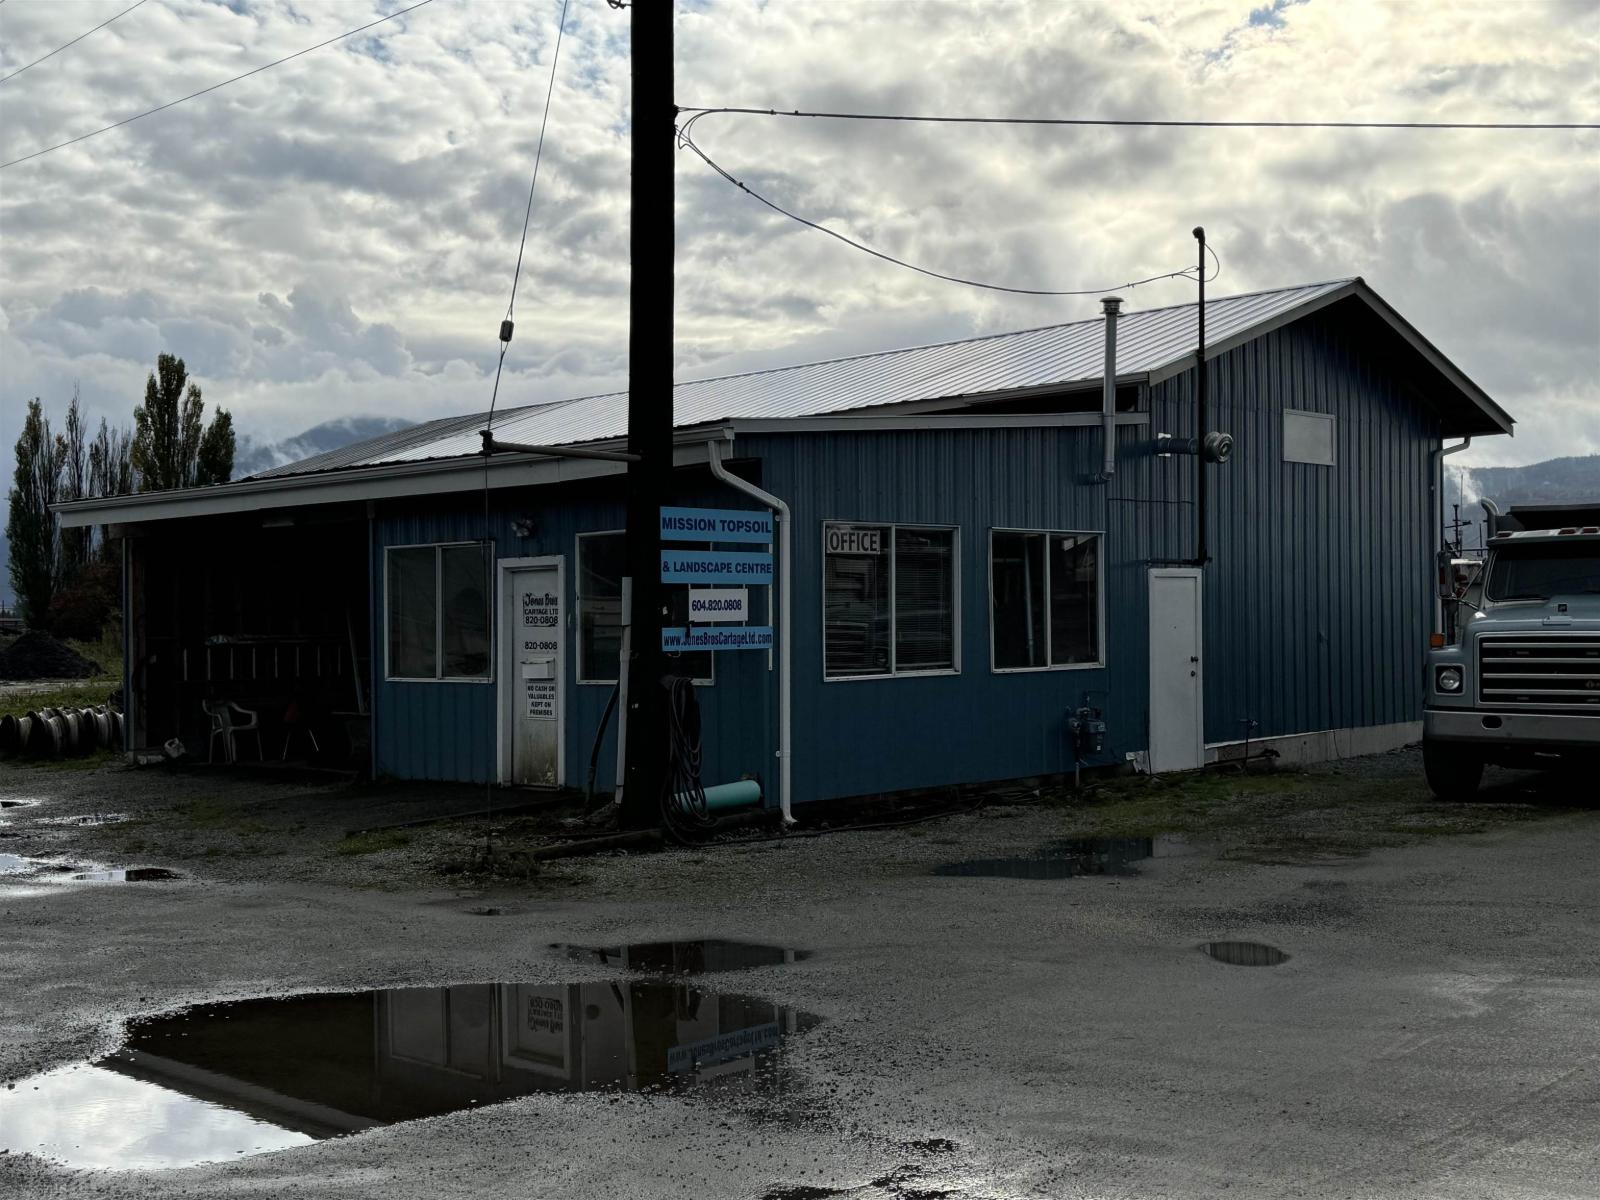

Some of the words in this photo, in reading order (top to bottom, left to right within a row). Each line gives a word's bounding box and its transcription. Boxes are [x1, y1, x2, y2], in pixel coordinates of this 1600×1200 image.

[662, 517, 716, 532] MISSION
[720, 520, 772, 534] TOPSOIL
[830, 531, 877, 552] OFFICE
[663, 561, 670, 571] &
[673, 561, 732, 574] LANDSCAPE
[735, 562, 772, 574] CENTRE
[691, 599, 742, 611] 604.820.0808
[525, 615, 558, 624] 820-0808
[525, 641, 557, 650] 820-0808
